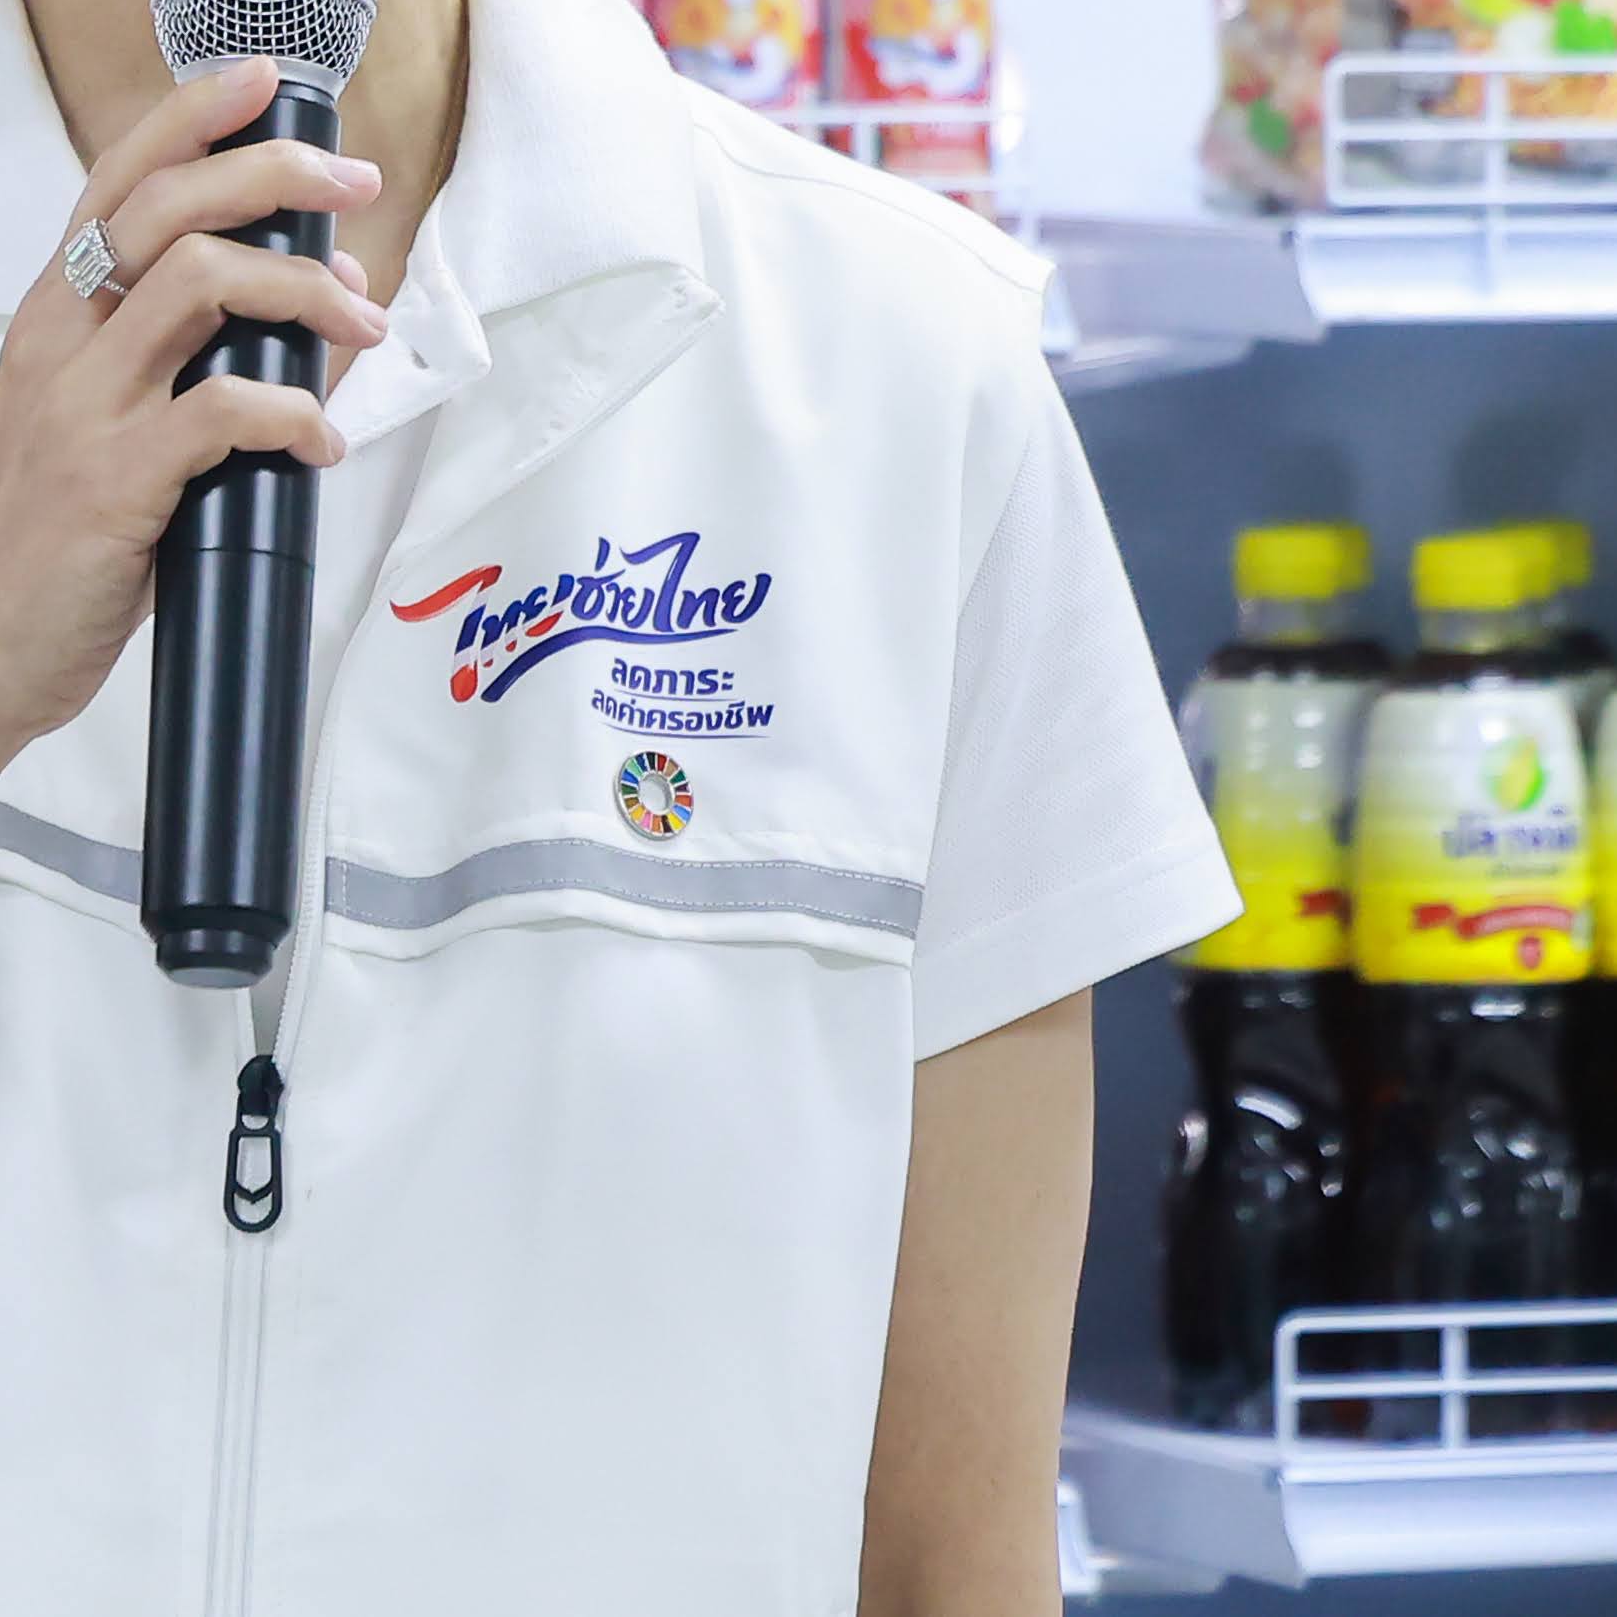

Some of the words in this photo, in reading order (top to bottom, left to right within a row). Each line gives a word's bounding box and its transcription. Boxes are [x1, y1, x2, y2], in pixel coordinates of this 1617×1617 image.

[389, 532, 772, 703] ไทยช่วยไทย
[611, 658, 734, 695] ลดภาระ
[590, 689, 773, 732] ลดค่าครองชีพ
